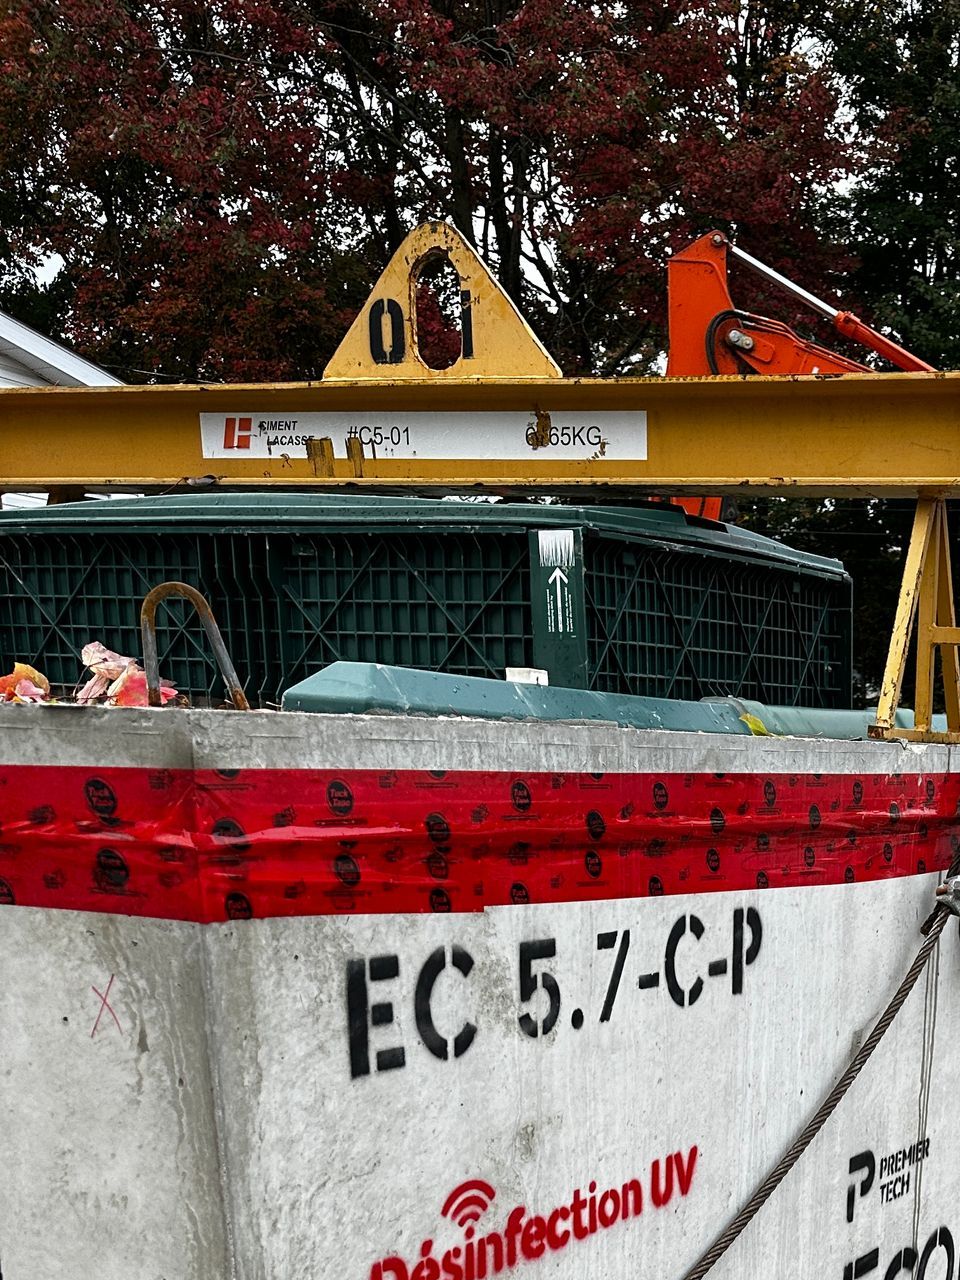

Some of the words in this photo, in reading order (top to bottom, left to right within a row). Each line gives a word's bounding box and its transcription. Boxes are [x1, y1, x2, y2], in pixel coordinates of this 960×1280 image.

[260, 420, 298, 431] CIMENT
[347, 944, 478, 1079] EC
[518, 906, 763, 1038] 5.7-C-P
[650, 1144, 698, 1208] UV
[879, 1137, 931, 1180] PREMIER
[879, 1171, 911, 1204] TECH
